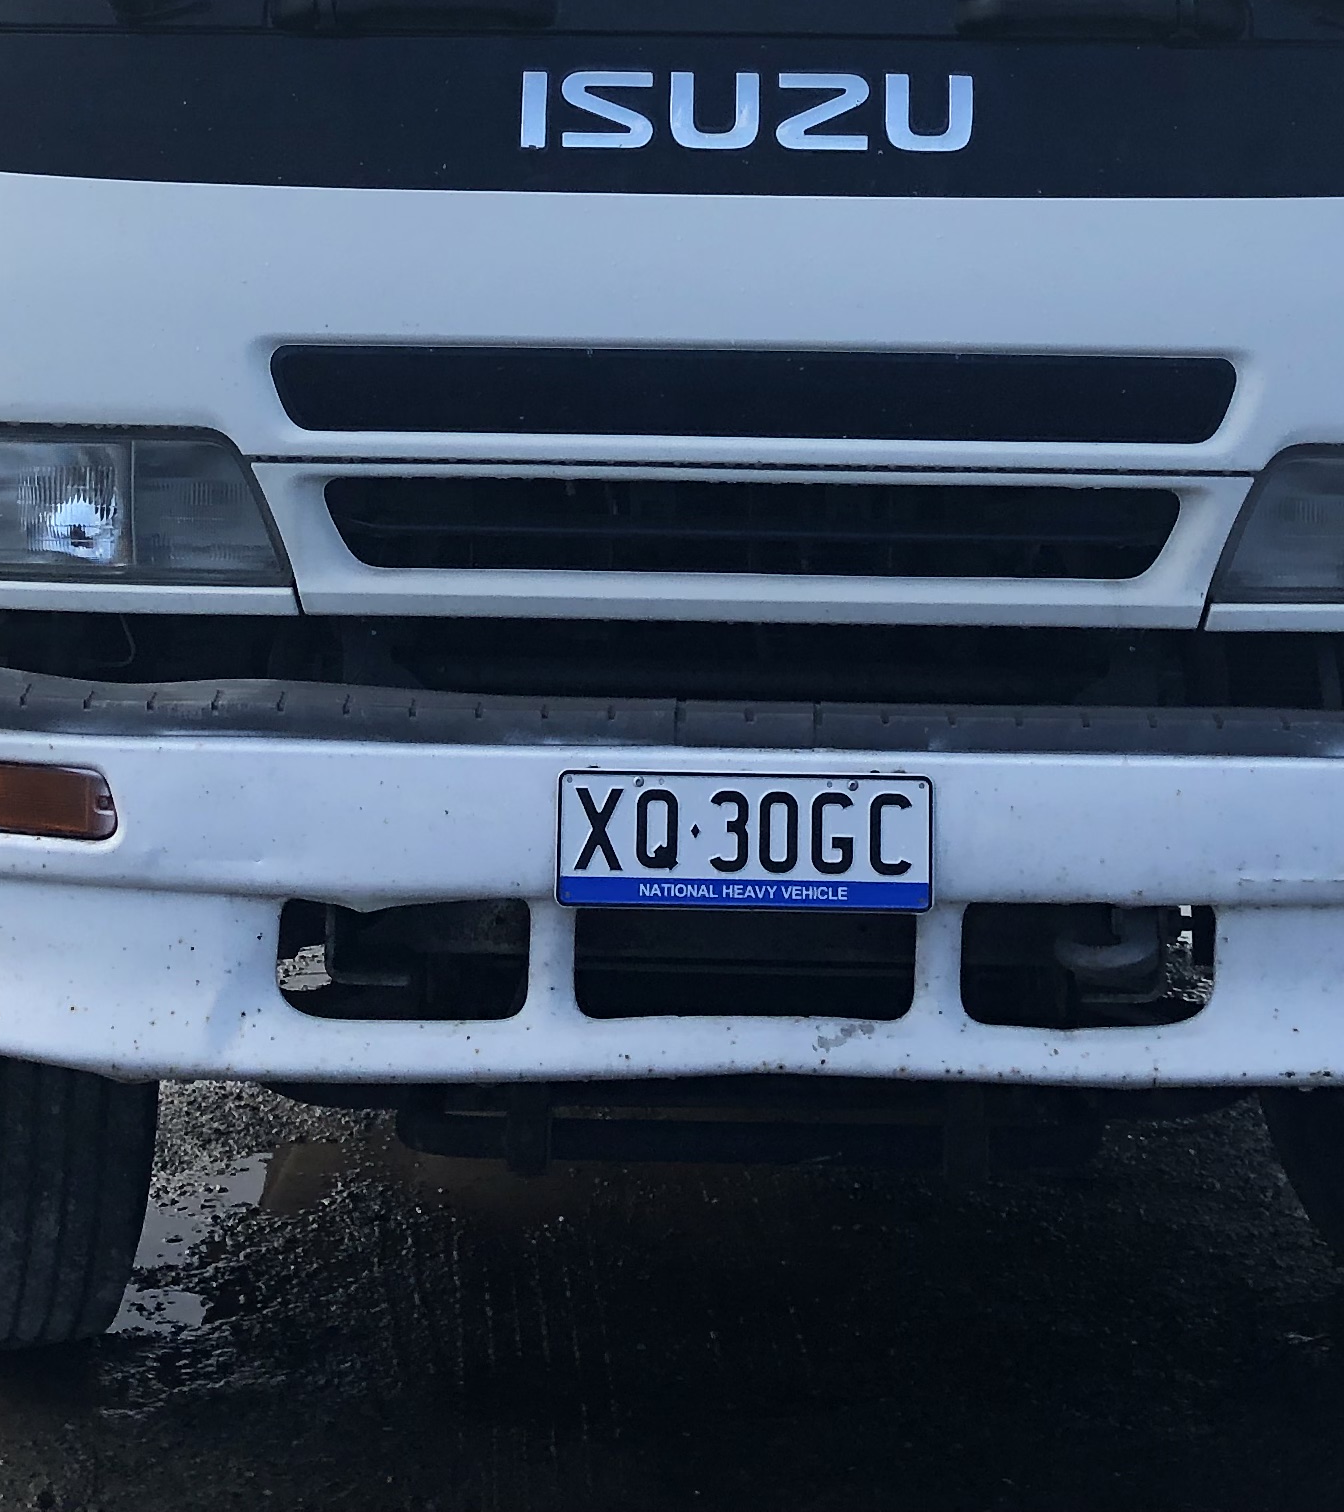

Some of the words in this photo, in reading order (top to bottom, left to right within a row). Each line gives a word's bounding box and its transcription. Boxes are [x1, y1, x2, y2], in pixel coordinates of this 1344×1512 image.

[520, 69, 974, 152] ISUZU
[639, 883, 719, 899] NATIONAL
[722, 884, 778, 899] HEAVY
[781, 885, 848, 901] VEHICLE
